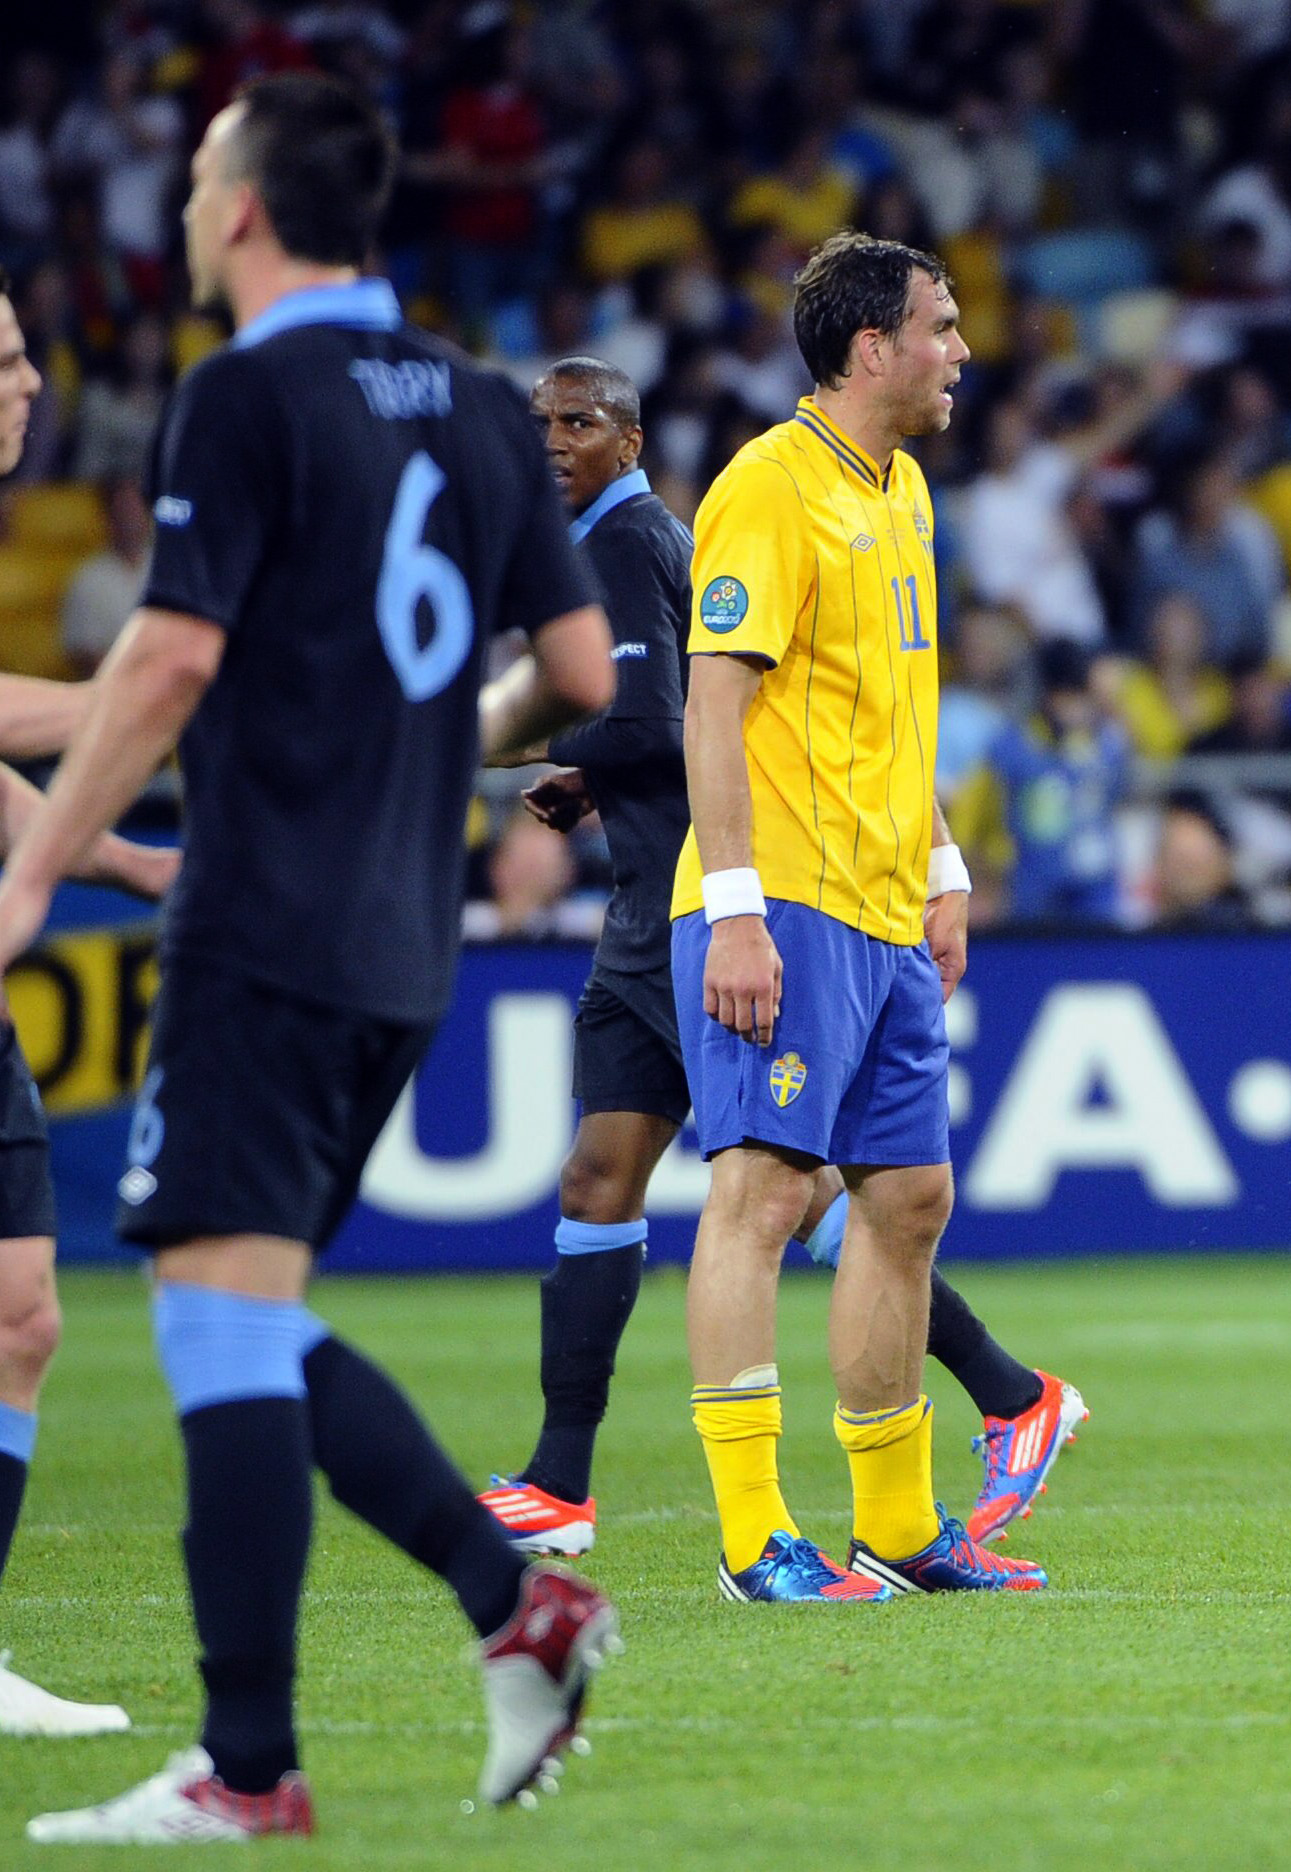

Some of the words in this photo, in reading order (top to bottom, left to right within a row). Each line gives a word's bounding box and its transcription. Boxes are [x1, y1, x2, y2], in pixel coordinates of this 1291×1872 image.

[375, 449, 476, 704] 6
[891, 575, 931, 652] 11
[127, 1064, 165, 1169] 6
